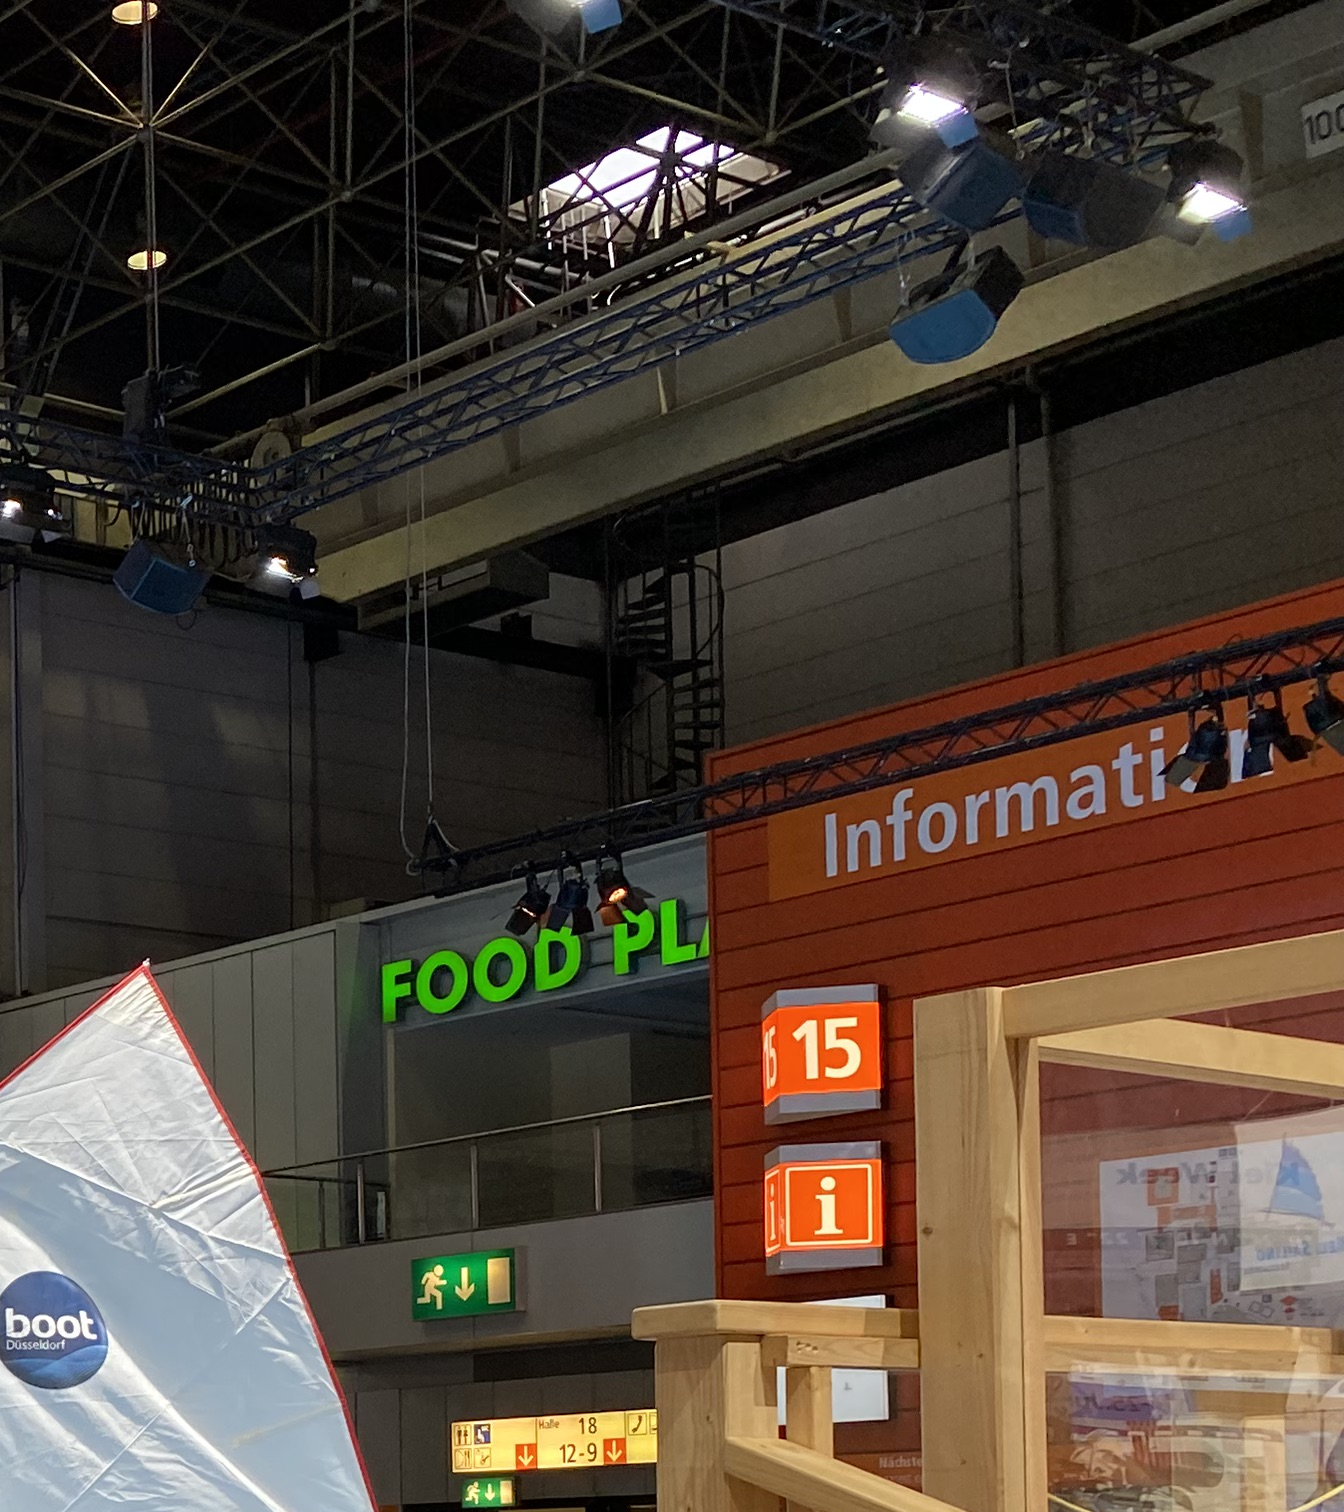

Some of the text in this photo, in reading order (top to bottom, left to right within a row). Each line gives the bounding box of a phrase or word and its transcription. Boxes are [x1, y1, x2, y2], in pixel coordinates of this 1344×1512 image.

[824, 726, 1275, 878] Informatin
[382, 898, 710, 1023] FOOD PL
[792, 1016, 862, 1080] 15
[5, 1307, 98, 1340] boot
[6, 1339, 66, 1350] Düsseldorf
[578, 1417, 598, 1435] 18
[559, 1442, 598, 1464] 12-9
